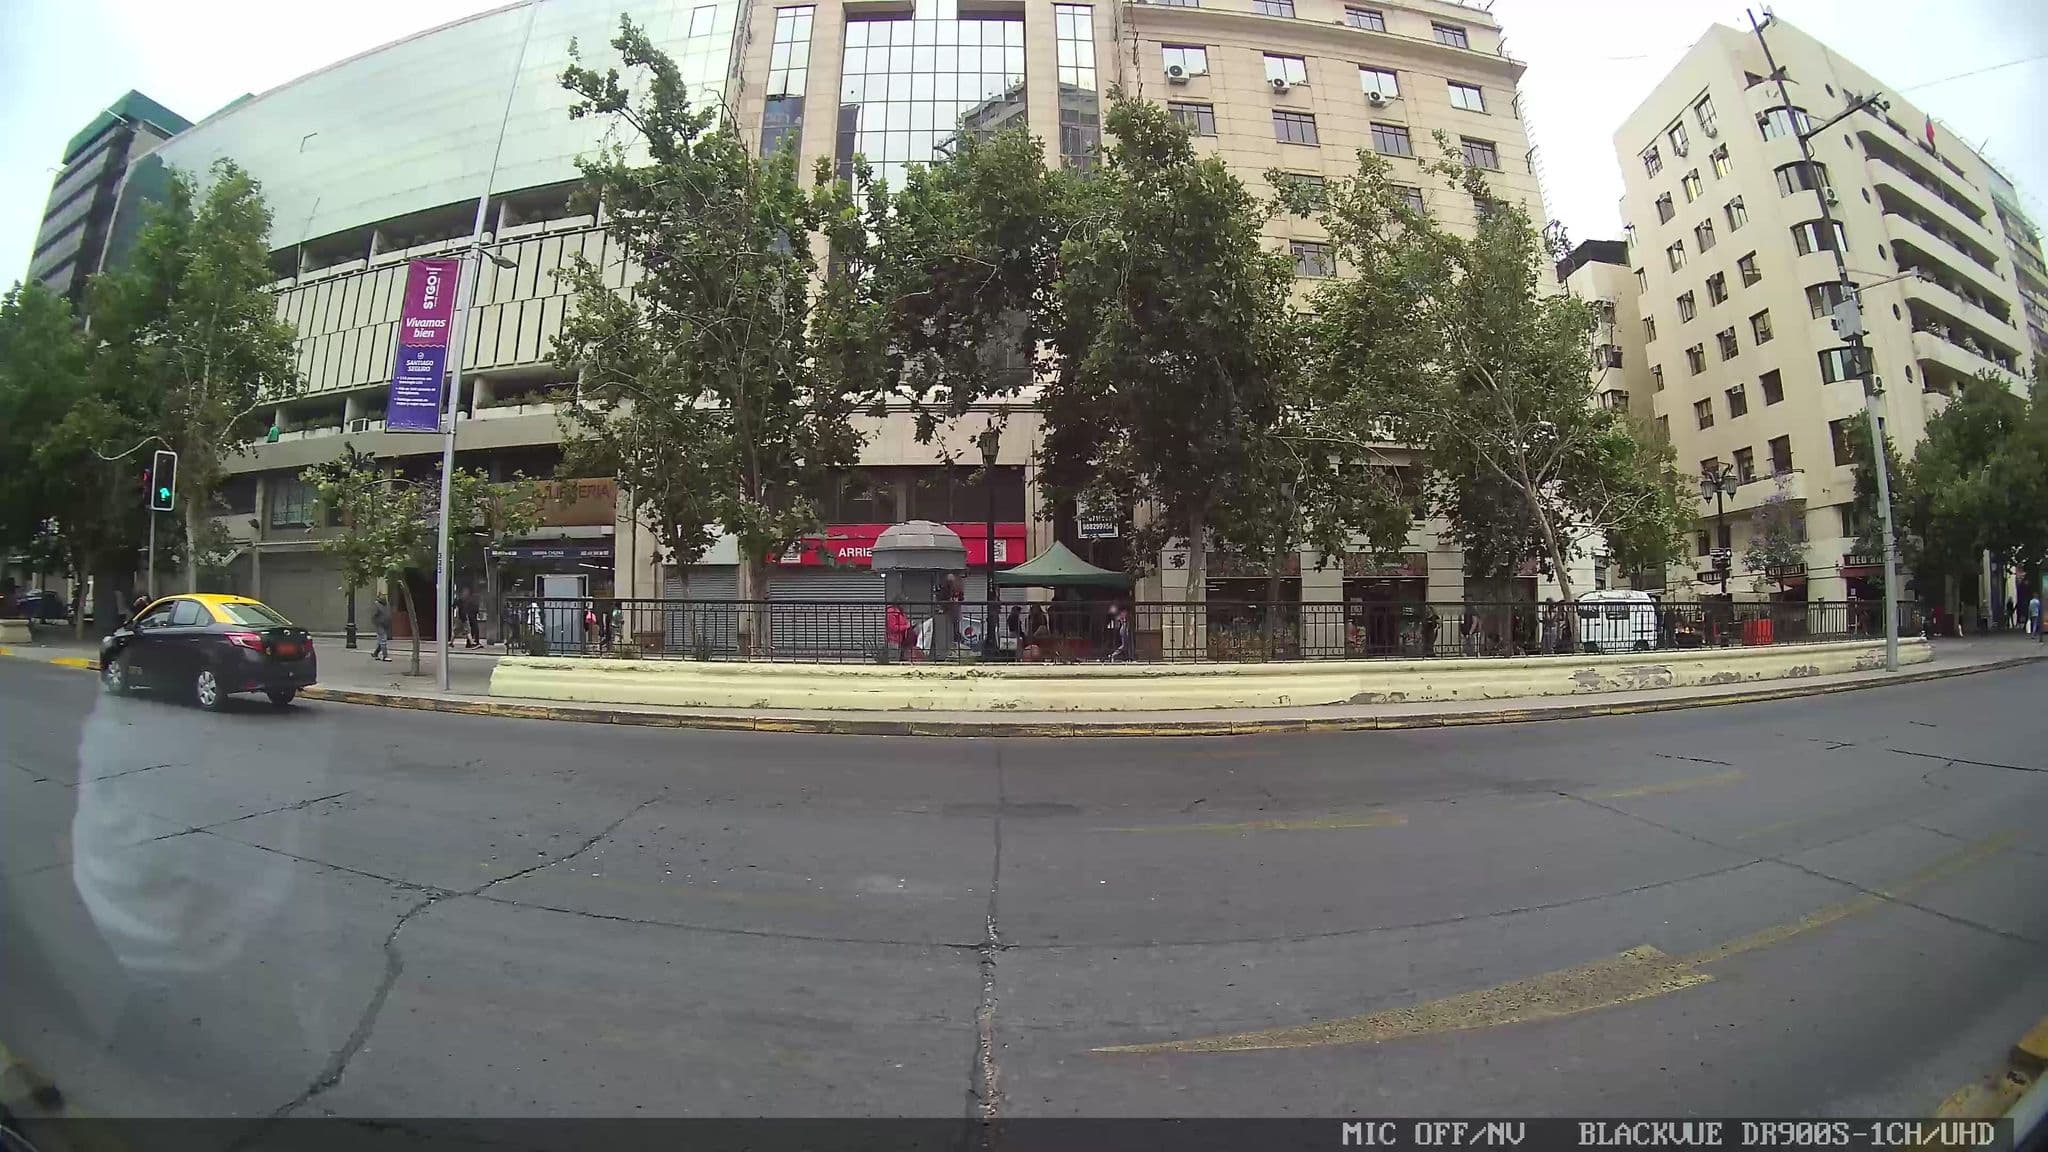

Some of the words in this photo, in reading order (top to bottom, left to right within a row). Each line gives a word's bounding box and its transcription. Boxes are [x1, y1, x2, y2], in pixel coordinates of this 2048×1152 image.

[423, 275, 438, 310] STGO
[406, 317, 446, 327] Vivamos
[413, 328, 435, 338] bien
